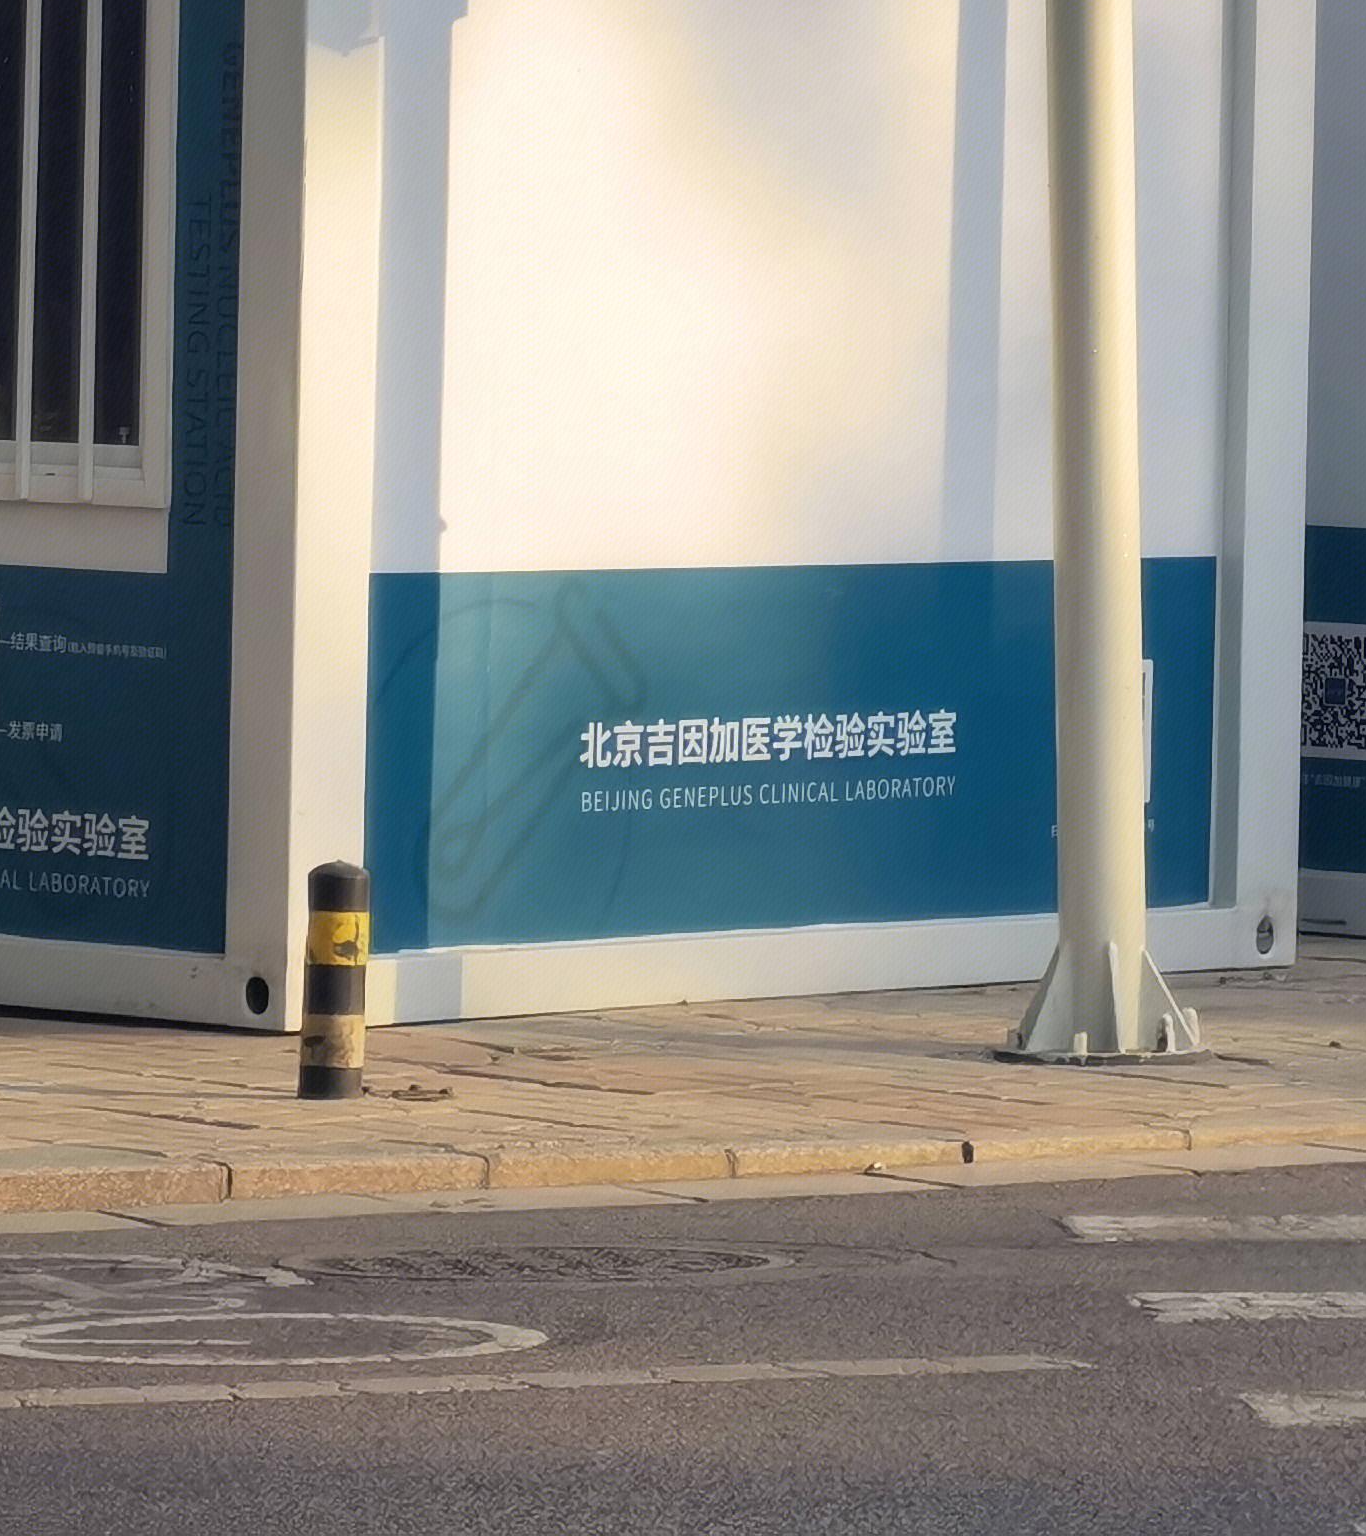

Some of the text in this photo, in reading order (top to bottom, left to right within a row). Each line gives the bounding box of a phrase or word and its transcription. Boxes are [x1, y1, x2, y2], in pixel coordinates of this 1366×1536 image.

[183, 191, 212, 527] TESTING STATION
[580, 708, 957, 768] 北京吉因加医学检验实验室
[581, 775, 956, 813] BEIJING GENEPLUS CLINICAL LABORATORY
[29, 872, 150, 899] LABORATORY
